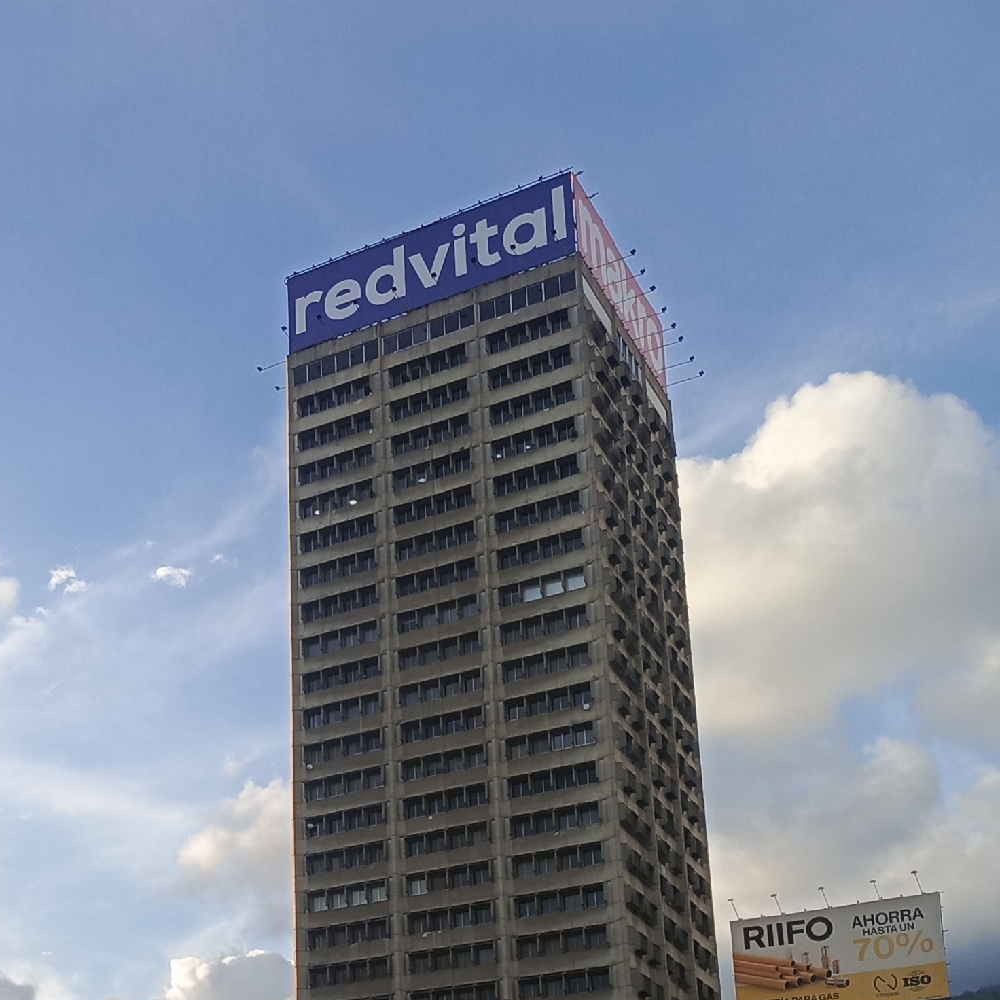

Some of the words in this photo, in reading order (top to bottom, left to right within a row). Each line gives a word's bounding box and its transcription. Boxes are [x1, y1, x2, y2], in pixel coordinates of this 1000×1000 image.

[294, 184, 568, 335] redvital
[578, 197, 664, 375] makro
[742, 916, 833, 950] RIIFO
[852, 907, 924, 929] AHORRA
[862, 923, 898, 937] HASTA
[899, 922, 915, 932] UN
[852, 929, 934, 962] 70%
[902, 974, 931, 987] ISO
